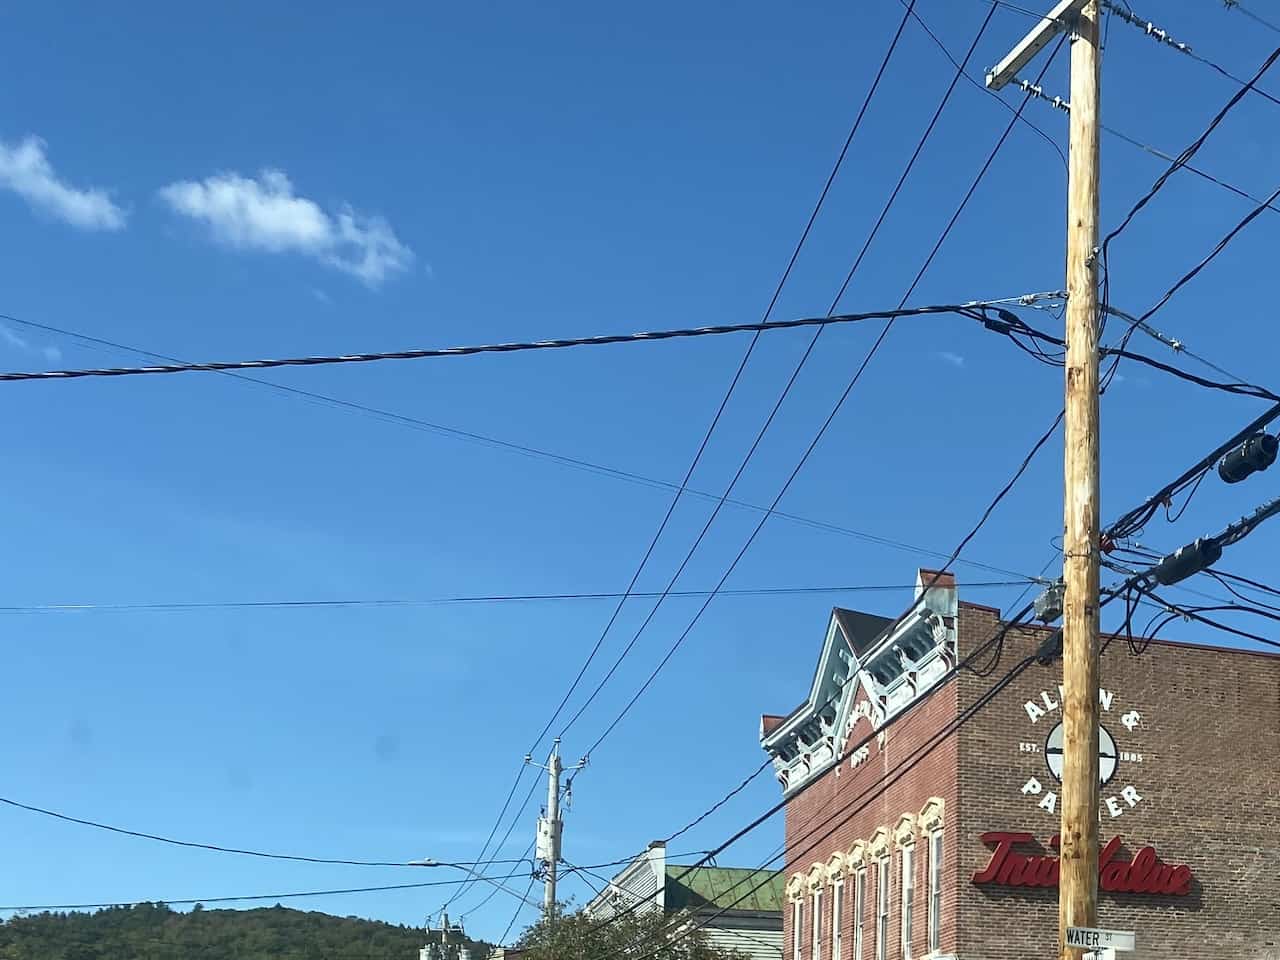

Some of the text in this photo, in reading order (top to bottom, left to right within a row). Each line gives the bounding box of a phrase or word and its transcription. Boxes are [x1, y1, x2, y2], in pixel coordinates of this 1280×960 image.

[1023, 684, 1114, 724] ALN
[1019, 742, 1040, 753] EST.
[1020, 776, 1144, 818] PAER
[1066, 928, 1100, 947] WATER
